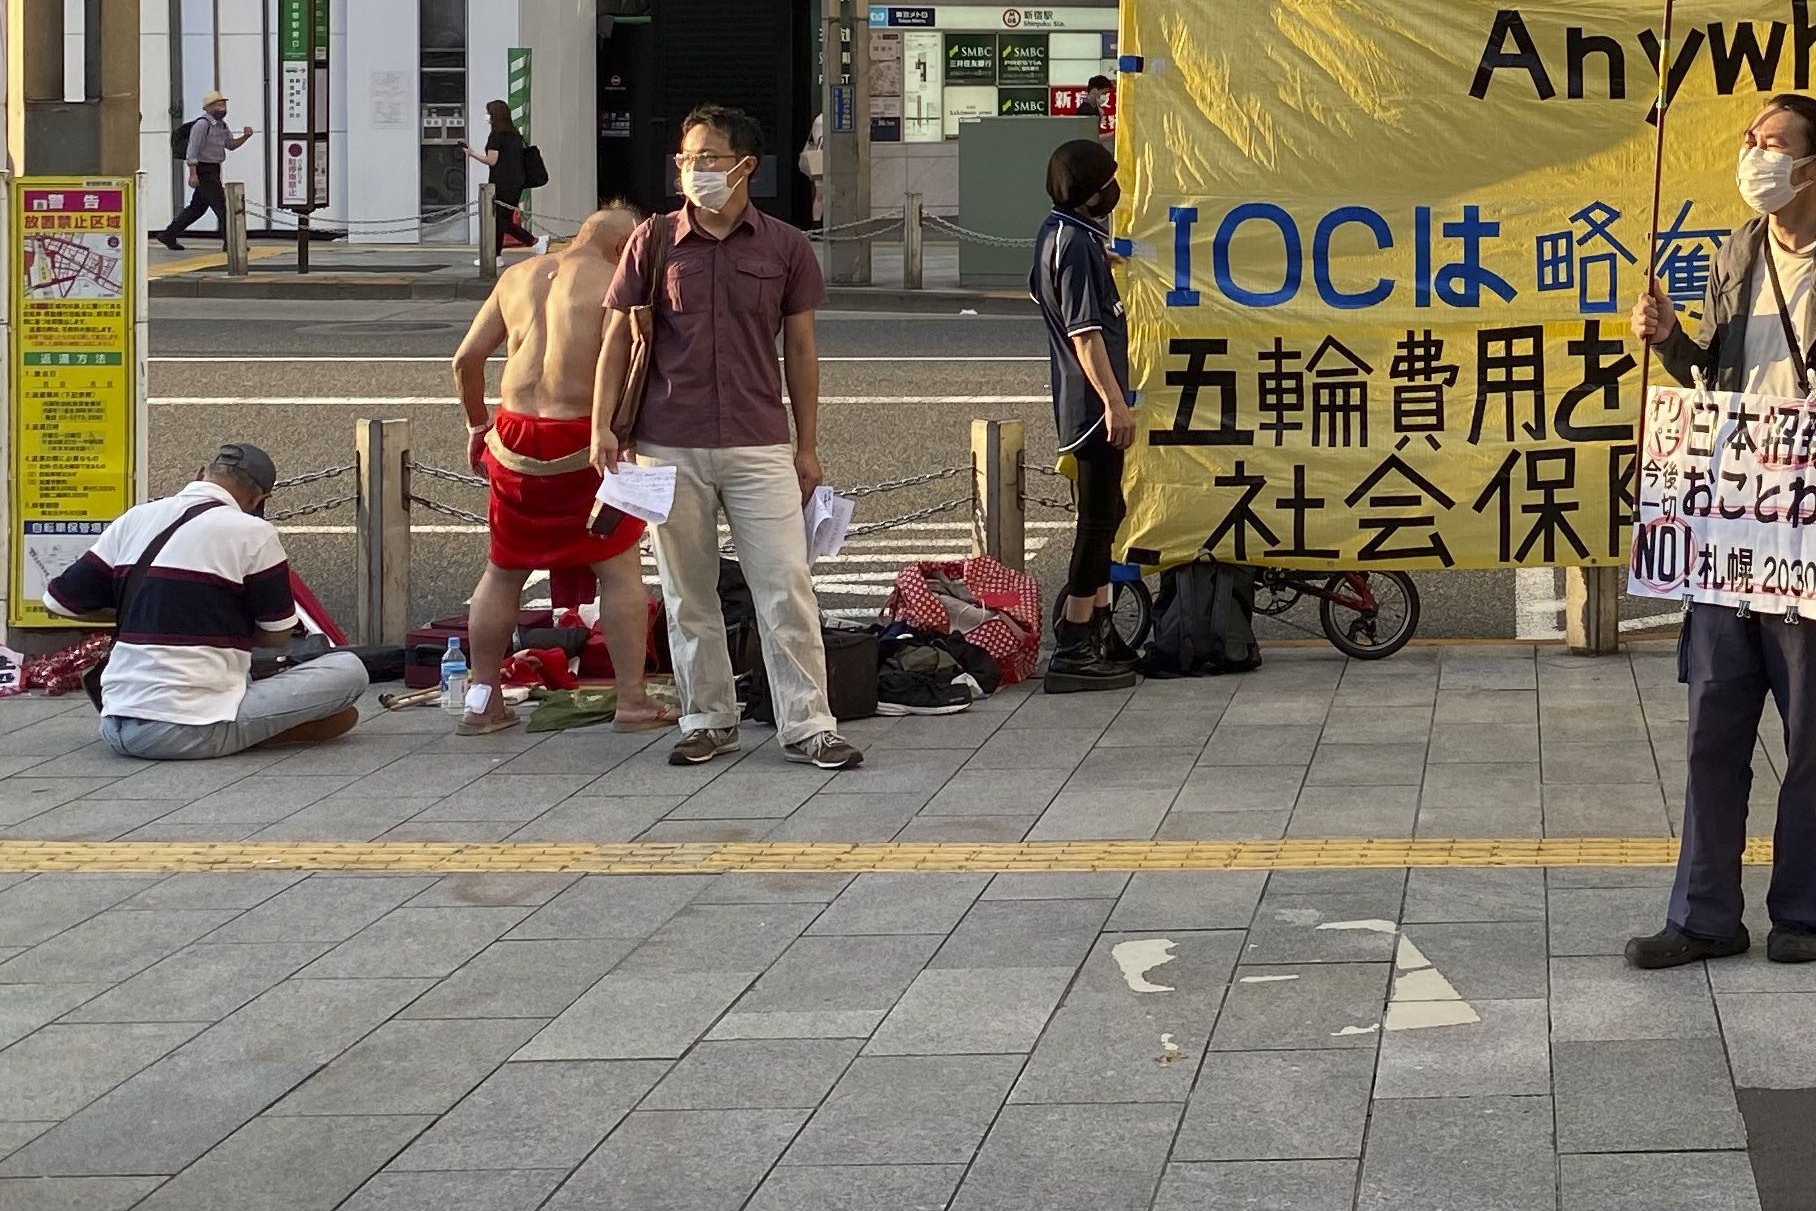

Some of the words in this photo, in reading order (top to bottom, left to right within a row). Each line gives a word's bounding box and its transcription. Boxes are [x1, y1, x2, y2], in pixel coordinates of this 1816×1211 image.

[1024, 10, 1054, 20] 新宿駅
[961, 46, 993, 57] SMBC
[1013, 46, 1045, 58] SMBC
[1013, 101, 1045, 112] SMBC
[1642, 459, 1679, 491] 今後
[1641, 493, 1678, 523] 一切
[1634, 522, 1691, 588] NO!
[1698, 542, 1754, 593] 札幌
